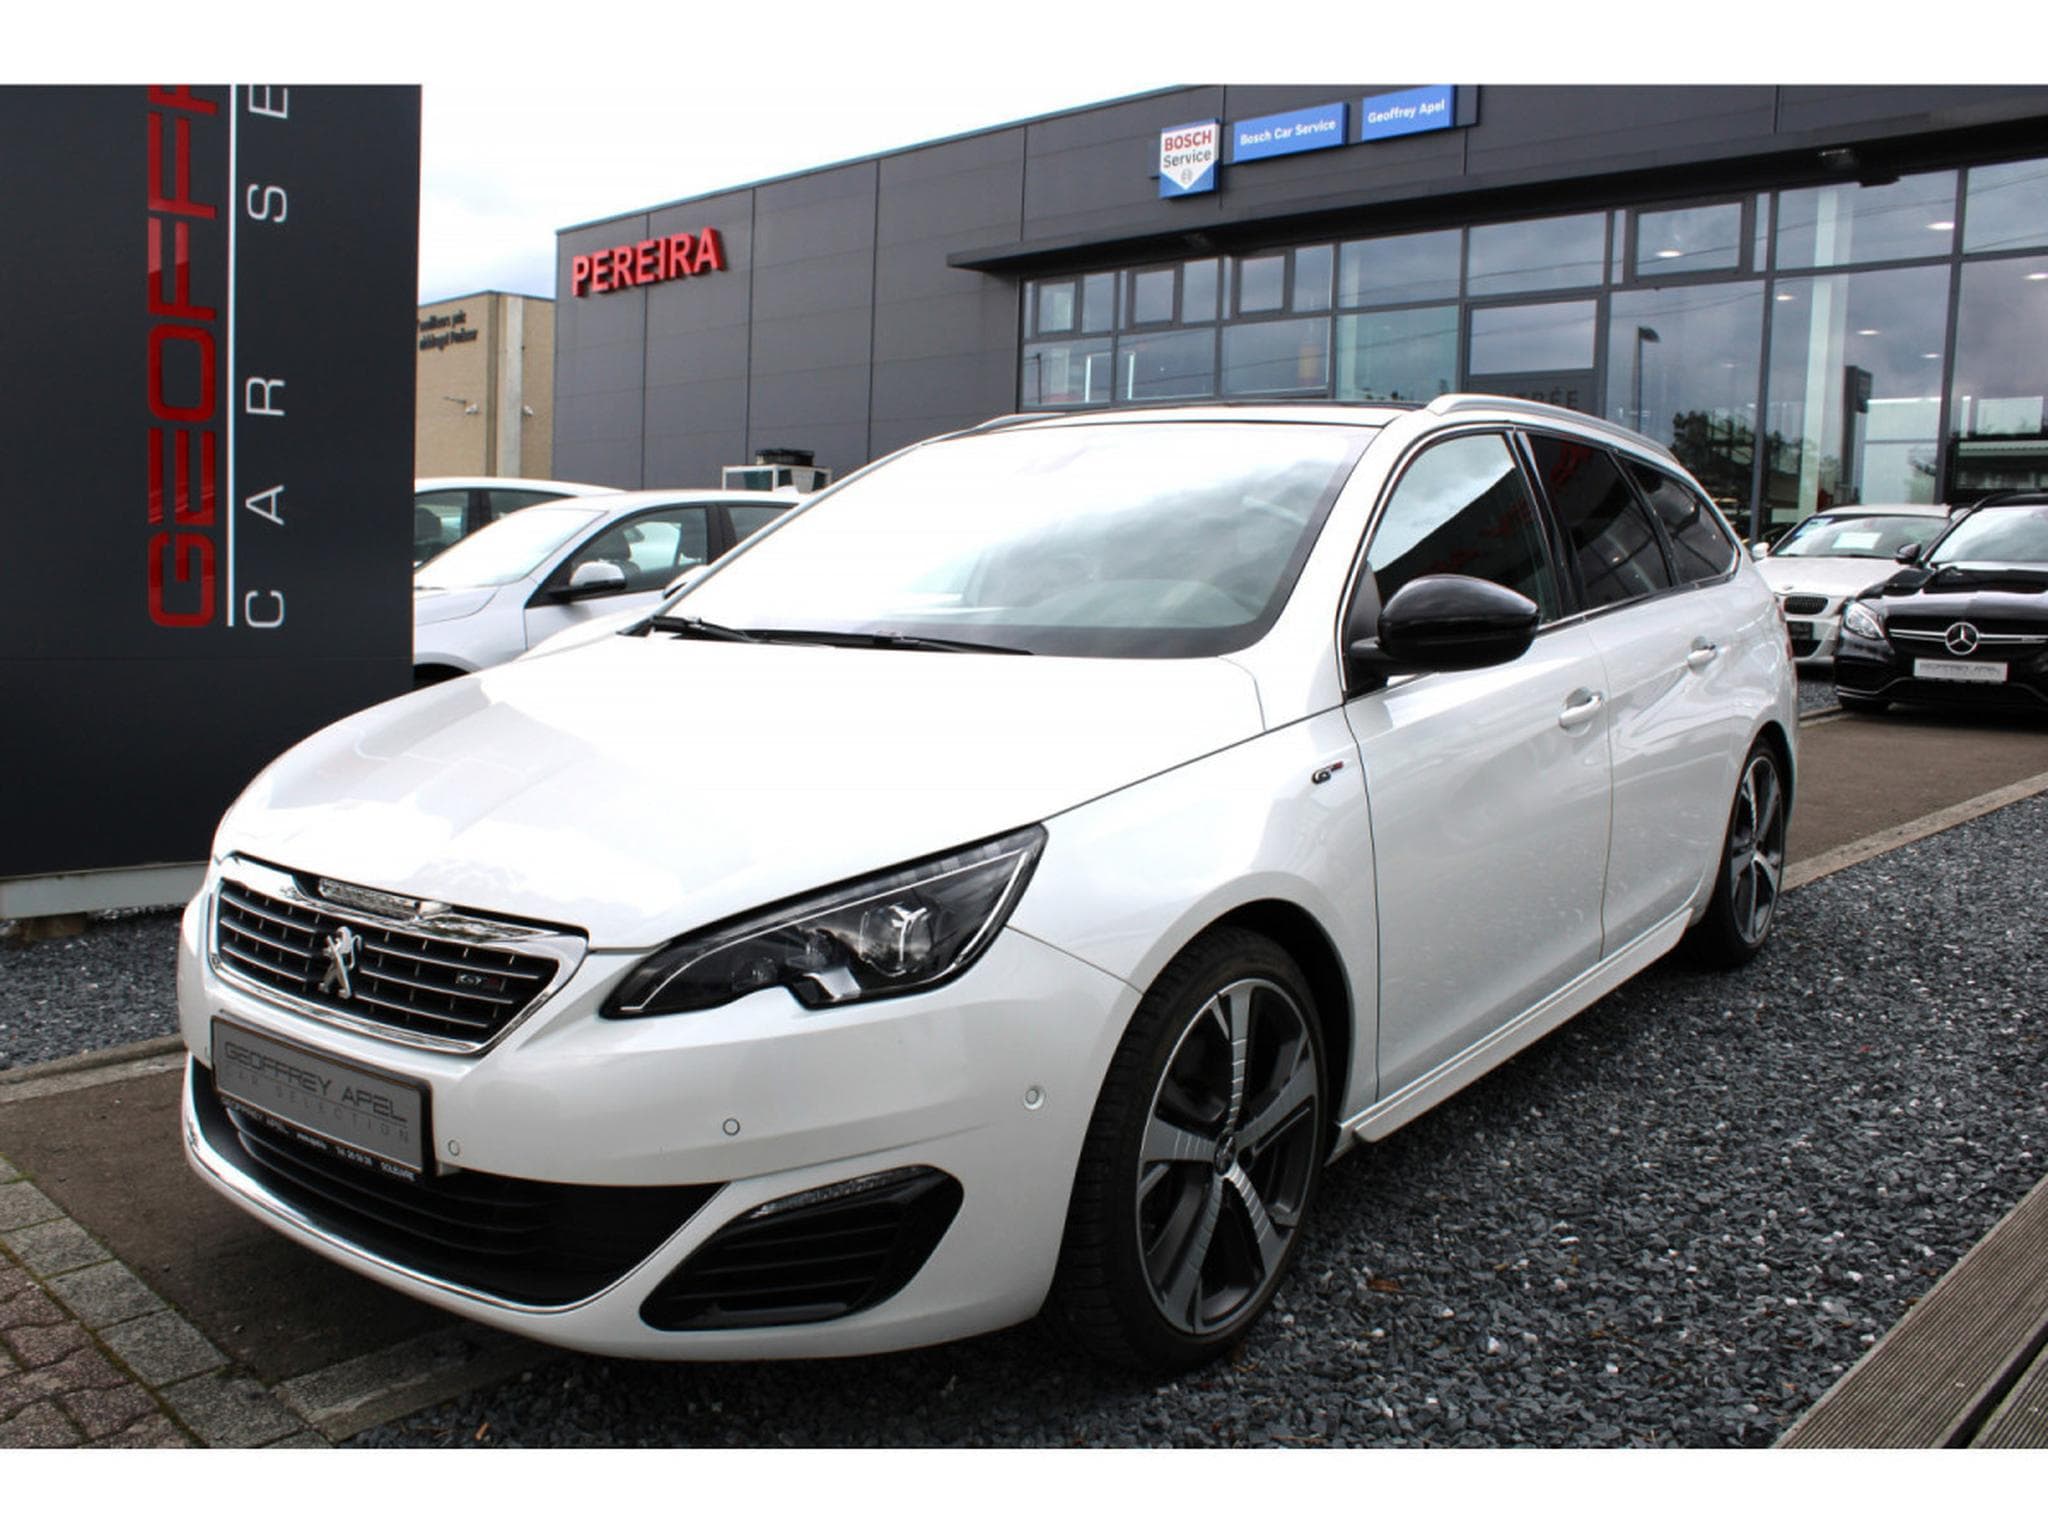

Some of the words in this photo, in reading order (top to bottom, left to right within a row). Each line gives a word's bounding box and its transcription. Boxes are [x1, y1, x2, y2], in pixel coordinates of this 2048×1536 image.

[1368, 106, 1416, 124] Geoffrey
[1419, 99, 1445, 115] Apel
[1164, 131, 1212, 152] BOSCH
[1239, 130, 1272, 146] Bosch
[1274, 127, 1293, 140] Car
[1295, 119, 1337, 137] Service
[1163, 149, 1212, 169] Service
[571, 226, 726, 297] PEREIRA
[224, 1041, 332, 1096] GEOFFREY
[341, 1085, 407, 1123] APEL
